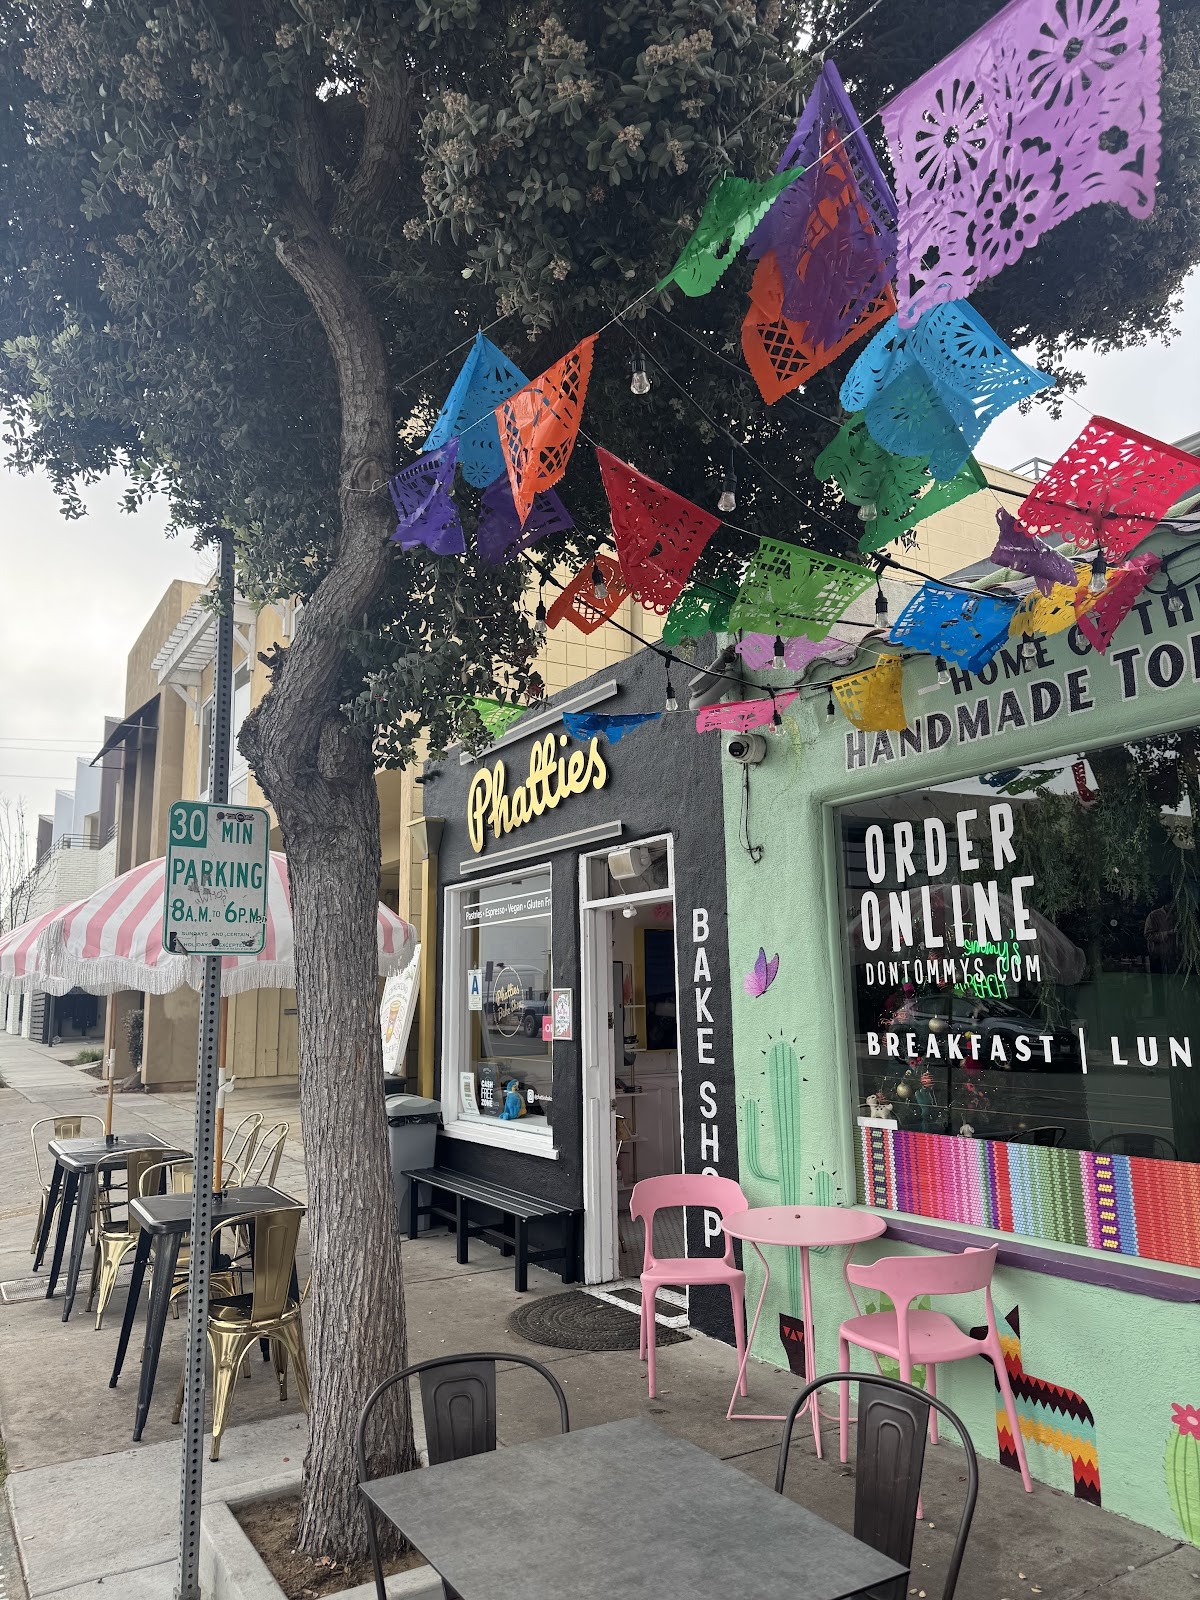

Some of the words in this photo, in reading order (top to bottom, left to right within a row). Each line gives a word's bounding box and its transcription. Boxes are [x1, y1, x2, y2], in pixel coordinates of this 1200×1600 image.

[949, 636, 1055, 695] HOME
[1131, 582, 1200, 636] TH
[845, 665, 1096, 772] HANDMADE
[467, 733, 607, 853] Phatties
[171, 808, 206, 842] 30
[221, 821, 254, 845] MIN
[864, 802, 1017, 884] ORDER
[172, 858, 263, 890] PARKING
[485, 906, 506, 919] Espresso
[507, 903, 524, 915] Vegan
[526, 898, 545, 910] Gluten
[860, 875, 1038, 953] ONLINE
[471, 975, 479, 995] A
[692, 907, 716, 1065] BAKE
[866, 1031, 1054, 1064] BREAKFAST
[1110, 1035, 1193, 1069] LUN
[481, 1079, 494, 1089] CASH
[481, 1087, 494, 1100] FREE
[481, 1098, 494, 1107] ZONE
